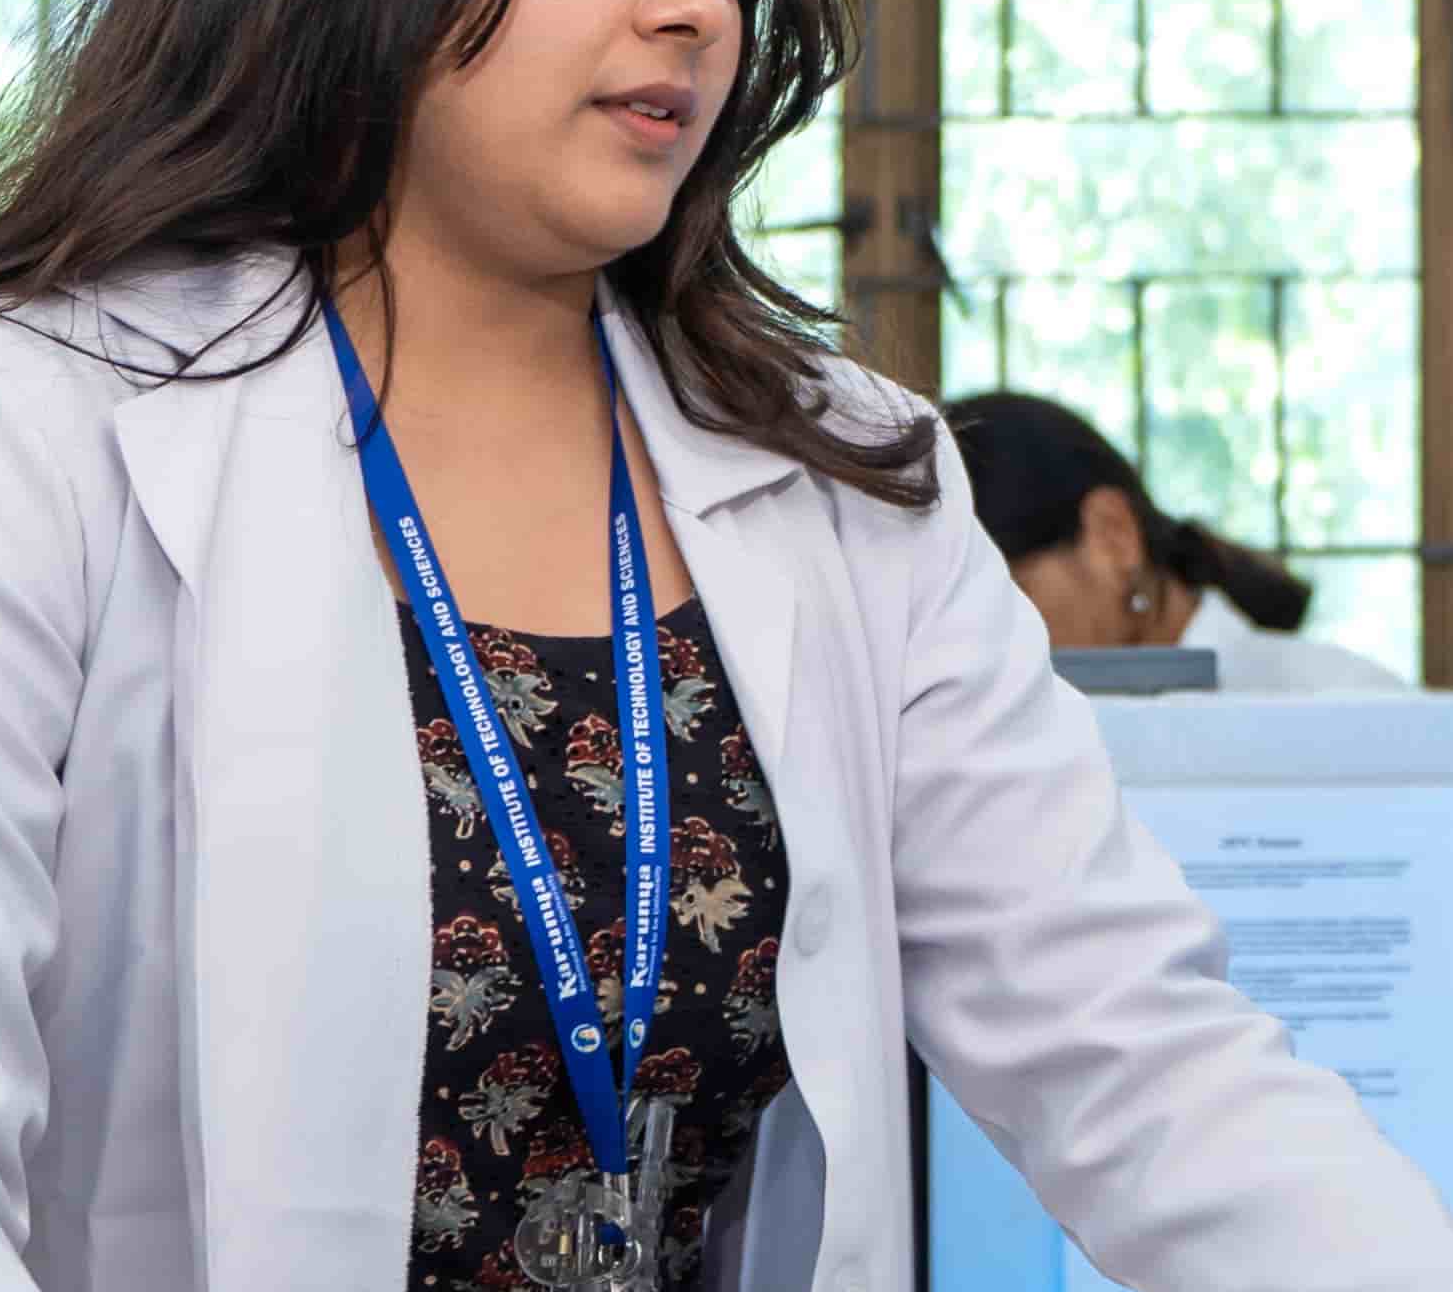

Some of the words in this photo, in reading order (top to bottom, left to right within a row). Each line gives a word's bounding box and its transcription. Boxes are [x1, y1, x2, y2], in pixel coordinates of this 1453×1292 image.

[399, 515, 443, 599] SCIENCES
[615, 513, 635, 590] SCIENCES
[432, 601, 458, 637] AND
[622, 593, 640, 626] AND
[445, 642, 502, 753] TECHNOLOGY
[625, 631, 651, 738] TECHNOLOGY
[488, 754, 511, 779] OF
[636, 741, 653, 765] OF
[498, 779, 543, 868] INSTITUTE
[636, 768, 657, 854] INSTITUTE
[531, 876, 578, 1002] Karunya
[630, 864, 654, 988] Karunya
